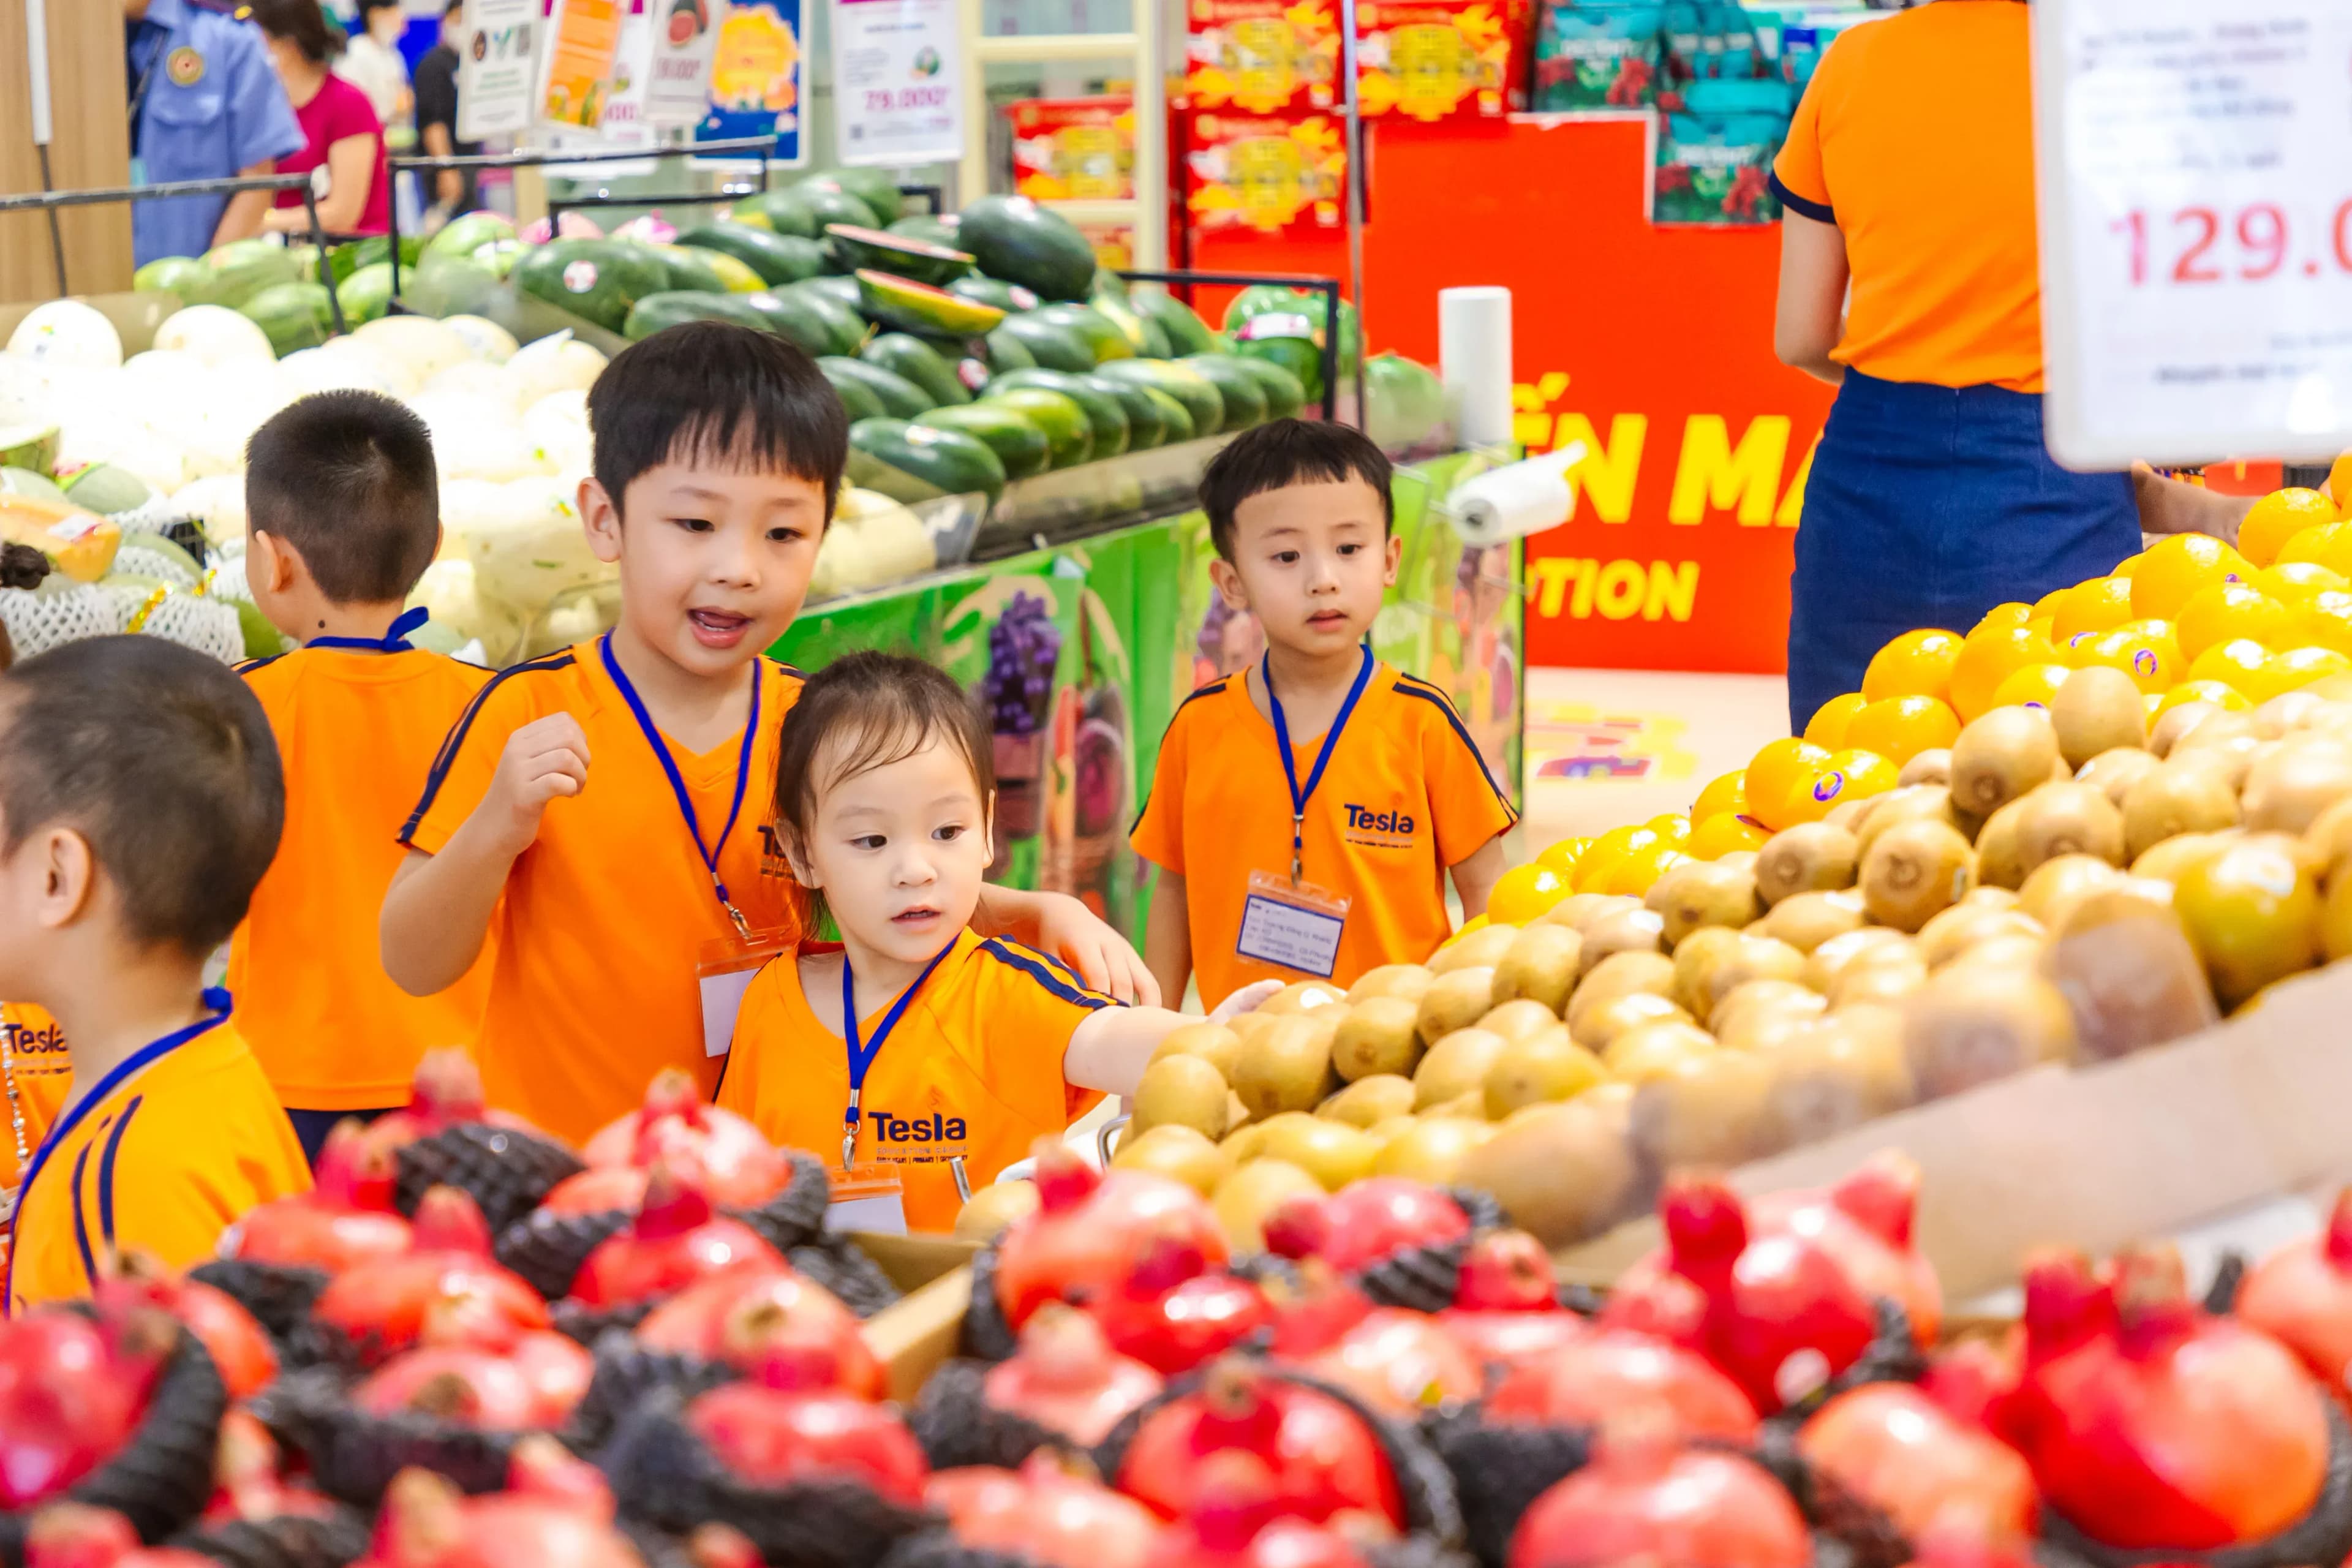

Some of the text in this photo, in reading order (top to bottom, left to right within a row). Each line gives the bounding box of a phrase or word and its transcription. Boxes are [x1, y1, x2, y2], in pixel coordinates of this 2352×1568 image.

[1525, 556, 1700, 622] TION
[1343, 803, 1414, 834] Tesla
[4, 1023, 69, 1054] Tesla
[868, 1112, 967, 1142] Tesla
